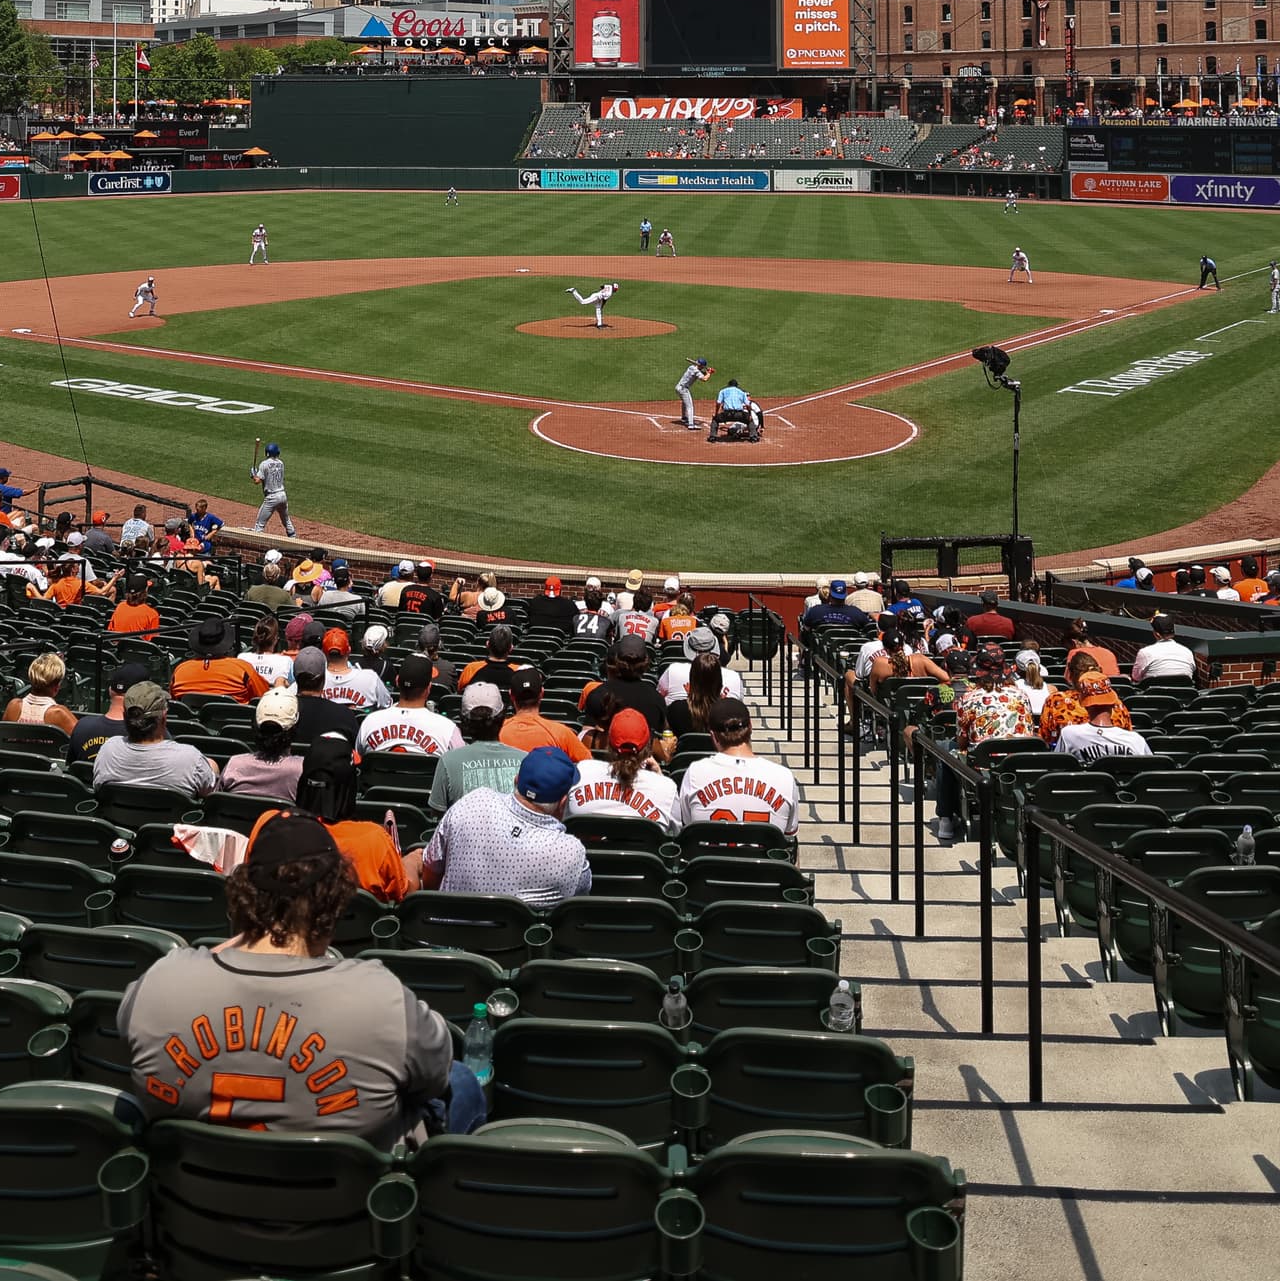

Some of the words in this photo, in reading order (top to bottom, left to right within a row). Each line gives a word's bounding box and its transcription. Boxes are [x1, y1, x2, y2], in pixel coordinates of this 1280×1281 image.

[795, 9, 837, 19] misses
[392, 9, 467, 37] Coors
[472, 19, 543, 37] LIGHT
[794, 23, 803, 32] a
[805, 21, 841, 34] pitch.
[391, 38, 442, 47] ROOF
[459, 38, 510, 47] DECK
[798, 49, 818, 58] PNC
[819, 49, 846, 58] BANK
[1099, 117, 1140, 127] Personal
[1142, 118, 1170, 127] Loans
[1177, 117, 1227, 127] MARINER
[1229, 117, 1278, 127] FINANCE
[178, 129, 200, 137] Ever?
[223, 153, 242, 161] Ever?
[97, 176, 142, 190] CareFirst
[679, 175, 719, 187] MedStar
[721, 175, 754, 187] Health
[1099, 179, 1136, 188] AUTUMN
[1138, 180, 1162, 188] LAKE
[1195, 179, 1255, 201] xfinity
[50, 378, 275, 415] GEICO
[577, 614, 599, 634] 24
[624, 621, 648, 640] 35
[321, 687, 366, 706] TSCHMAN
[367, 725, 439, 755] HENDERSON
[462, 759, 490, 770] NOAH
[493, 759, 522, 768] KAHA
[696, 777, 786, 812] RUTSCHMAN
[574, 782, 661, 823] SANTANDER
[145, 1005, 360, 1118] B.ROBINSON
